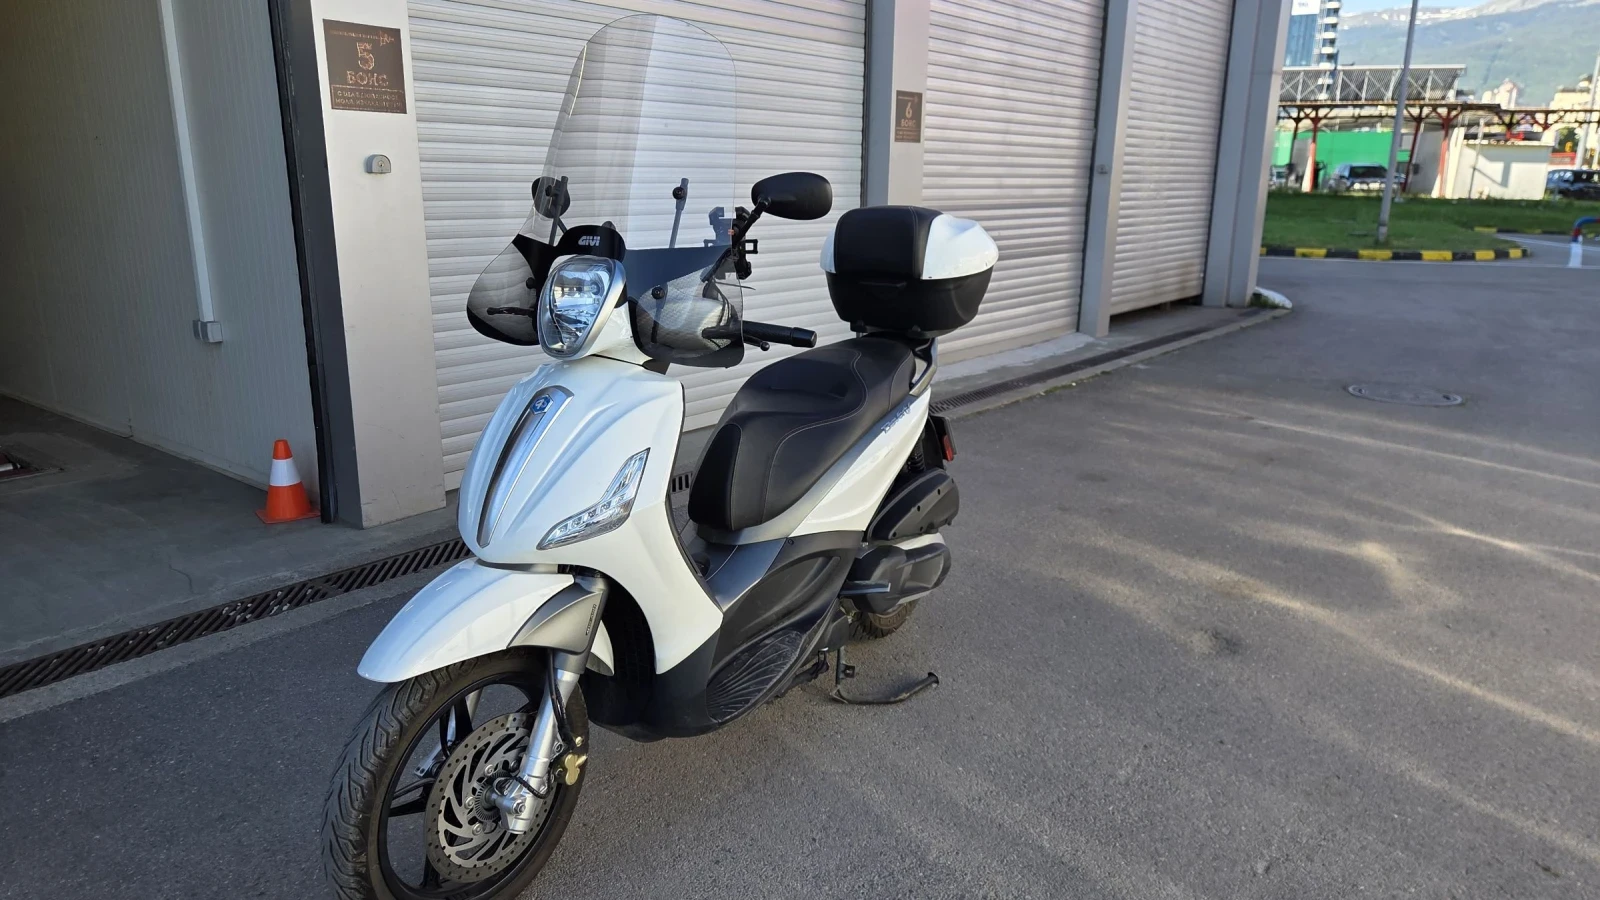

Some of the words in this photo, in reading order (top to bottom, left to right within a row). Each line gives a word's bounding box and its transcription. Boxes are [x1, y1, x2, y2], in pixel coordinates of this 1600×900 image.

[356, 42, 375, 70] 5
[906, 102, 912, 118] 6
[578, 235, 601, 247] GIVI
